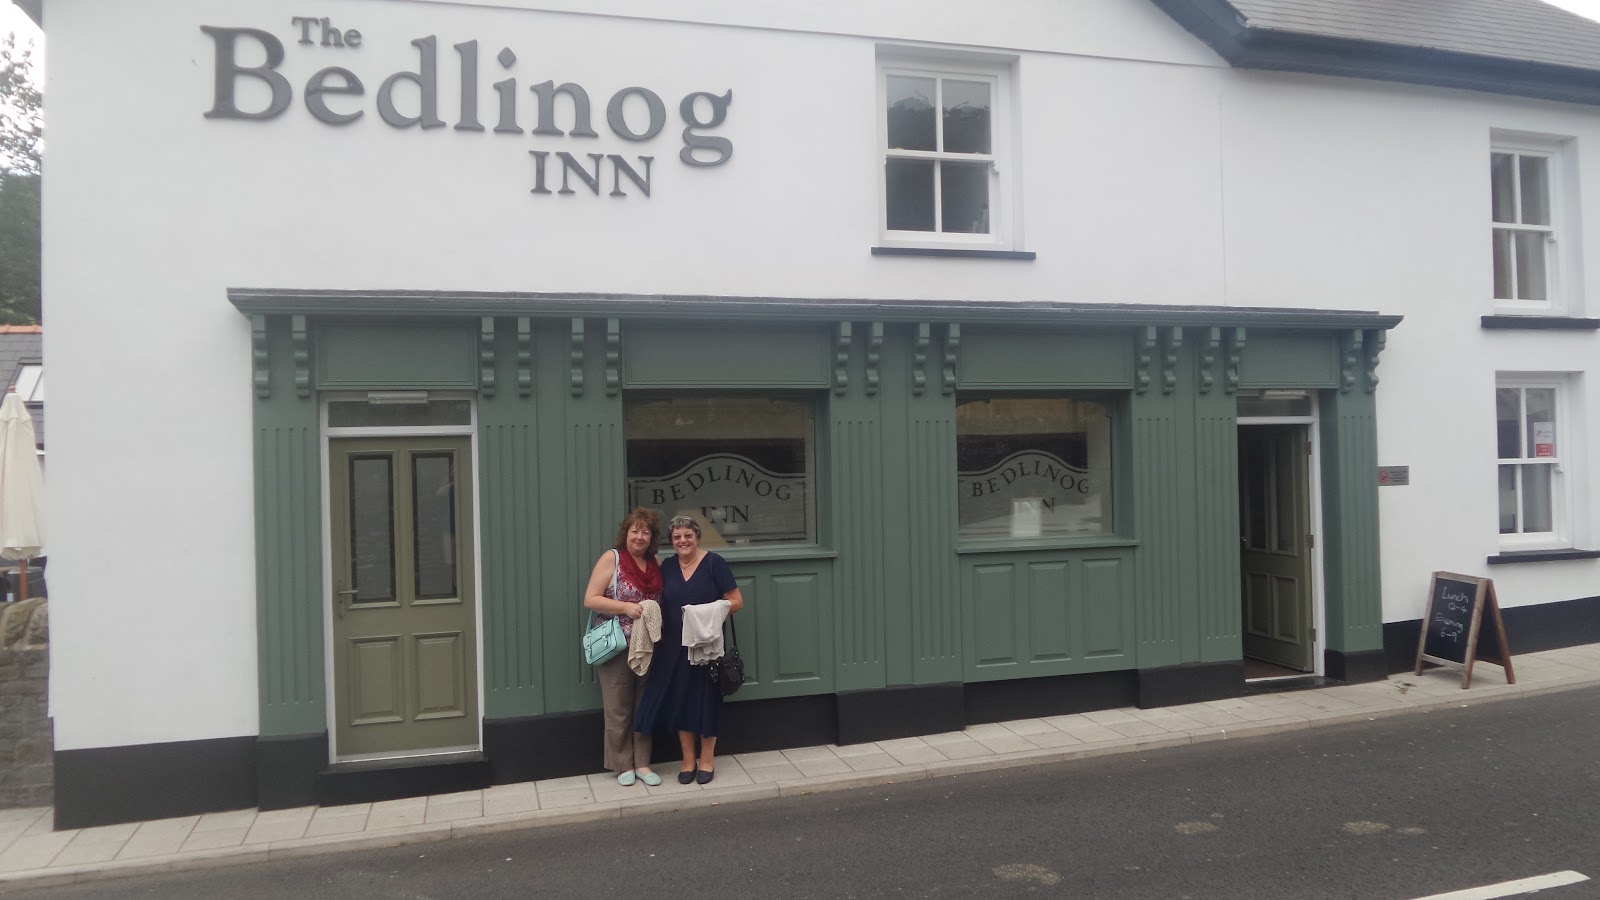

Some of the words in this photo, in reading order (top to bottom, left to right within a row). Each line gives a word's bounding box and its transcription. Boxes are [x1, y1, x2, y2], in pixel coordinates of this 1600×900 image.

[292, 16, 362, 48] The
[200, 24, 734, 166] Bedlinog
[529, 150, 655, 198] INN
[652, 465, 791, 505] BEDLINOG
[972, 460, 1088, 497] BEDLINOG
[1441, 586, 1469, 604] Lunch
